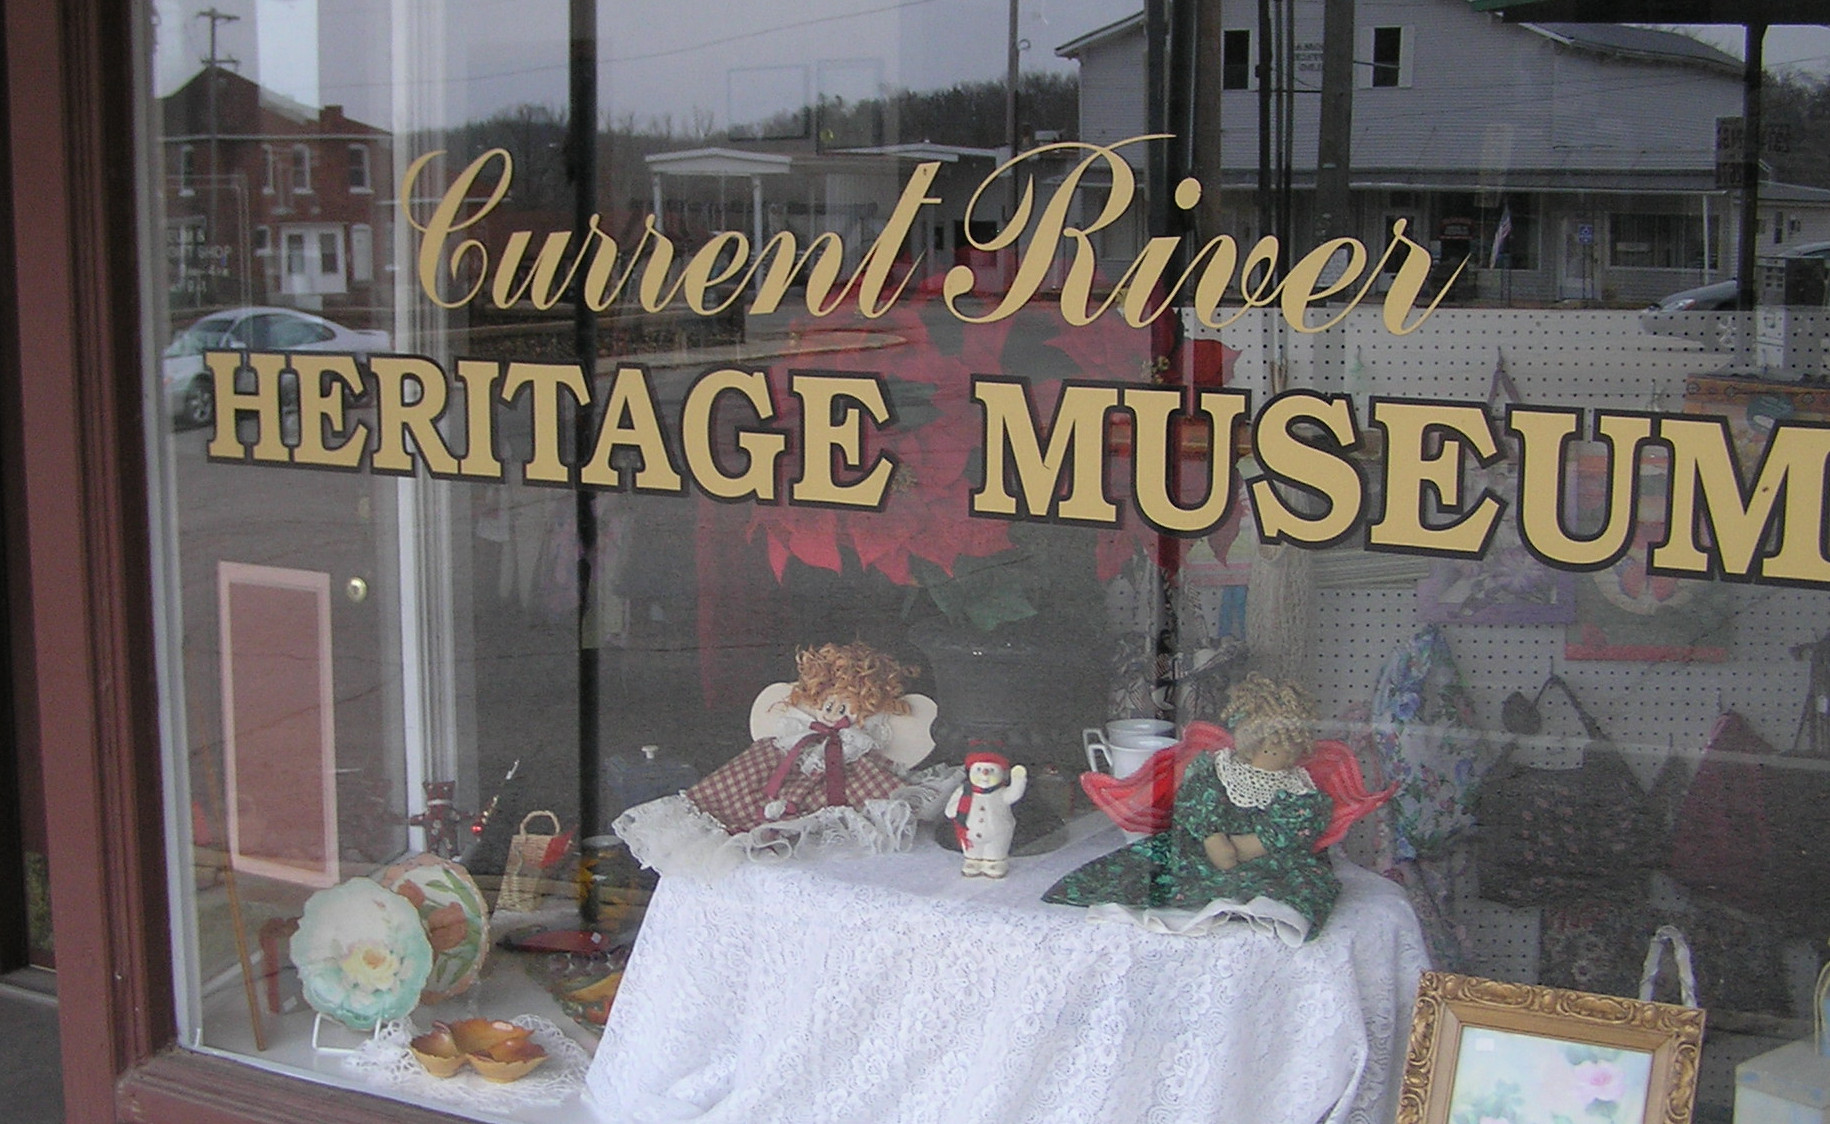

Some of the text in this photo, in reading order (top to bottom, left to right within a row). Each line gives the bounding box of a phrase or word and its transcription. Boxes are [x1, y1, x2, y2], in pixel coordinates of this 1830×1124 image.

[400, 133, 1470, 336] Current River
[205, 350, 1830, 590] HERITAGE MUSEUM
